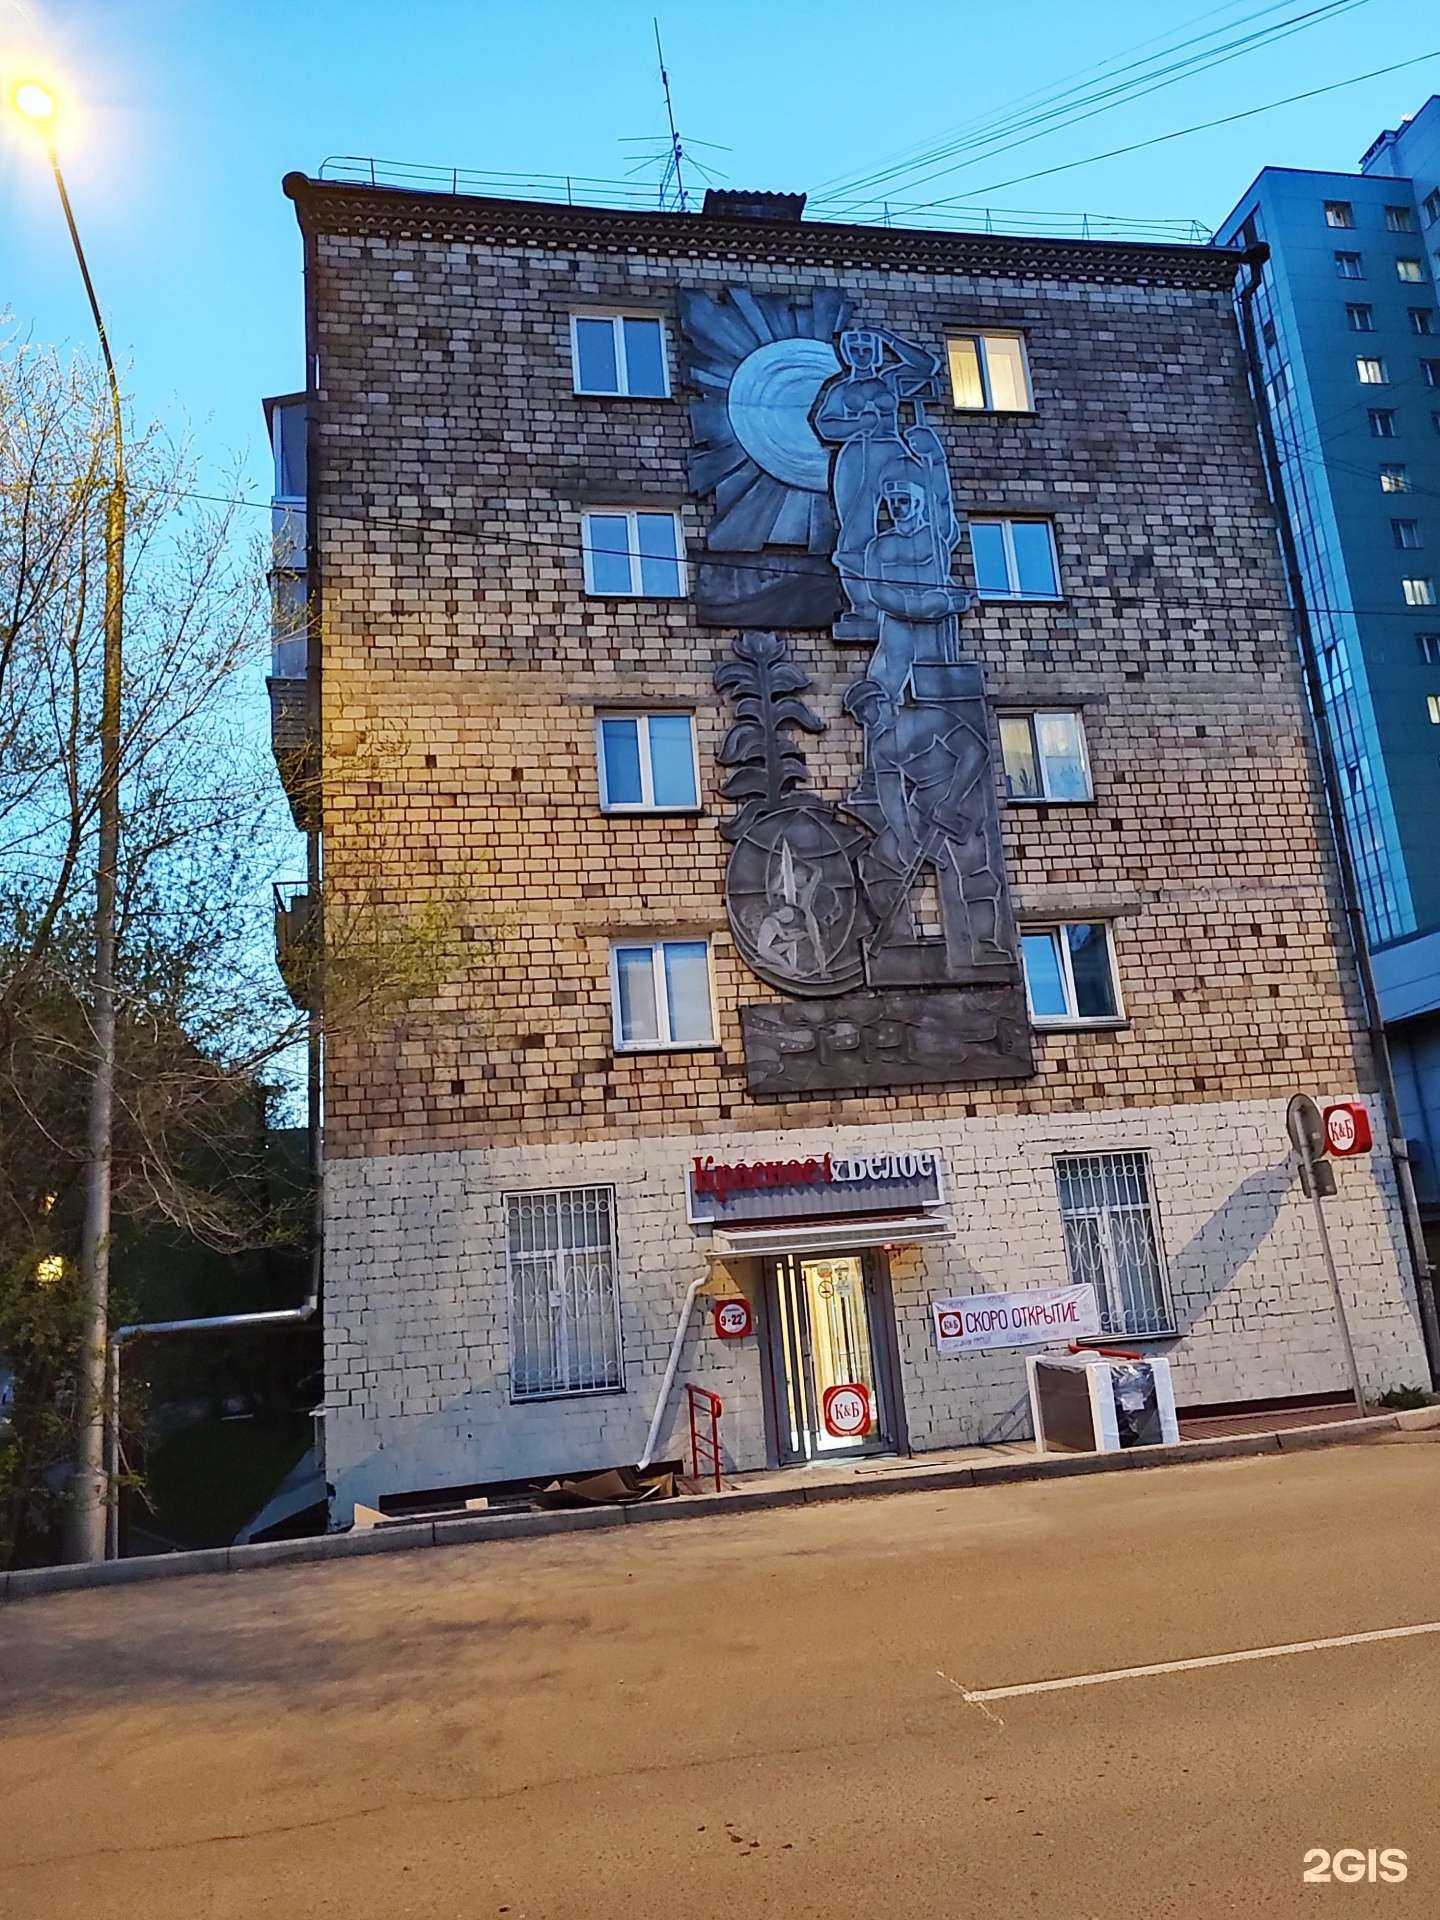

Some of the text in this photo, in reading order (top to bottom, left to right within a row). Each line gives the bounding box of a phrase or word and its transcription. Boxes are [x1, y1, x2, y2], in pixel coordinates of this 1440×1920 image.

[1330, 1119, 1353, 1141] К&Б
[965, 1302, 1080, 1333] СКОРО ОТКРЫТИЕ
[835, 1402, 859, 1420] К&Б
